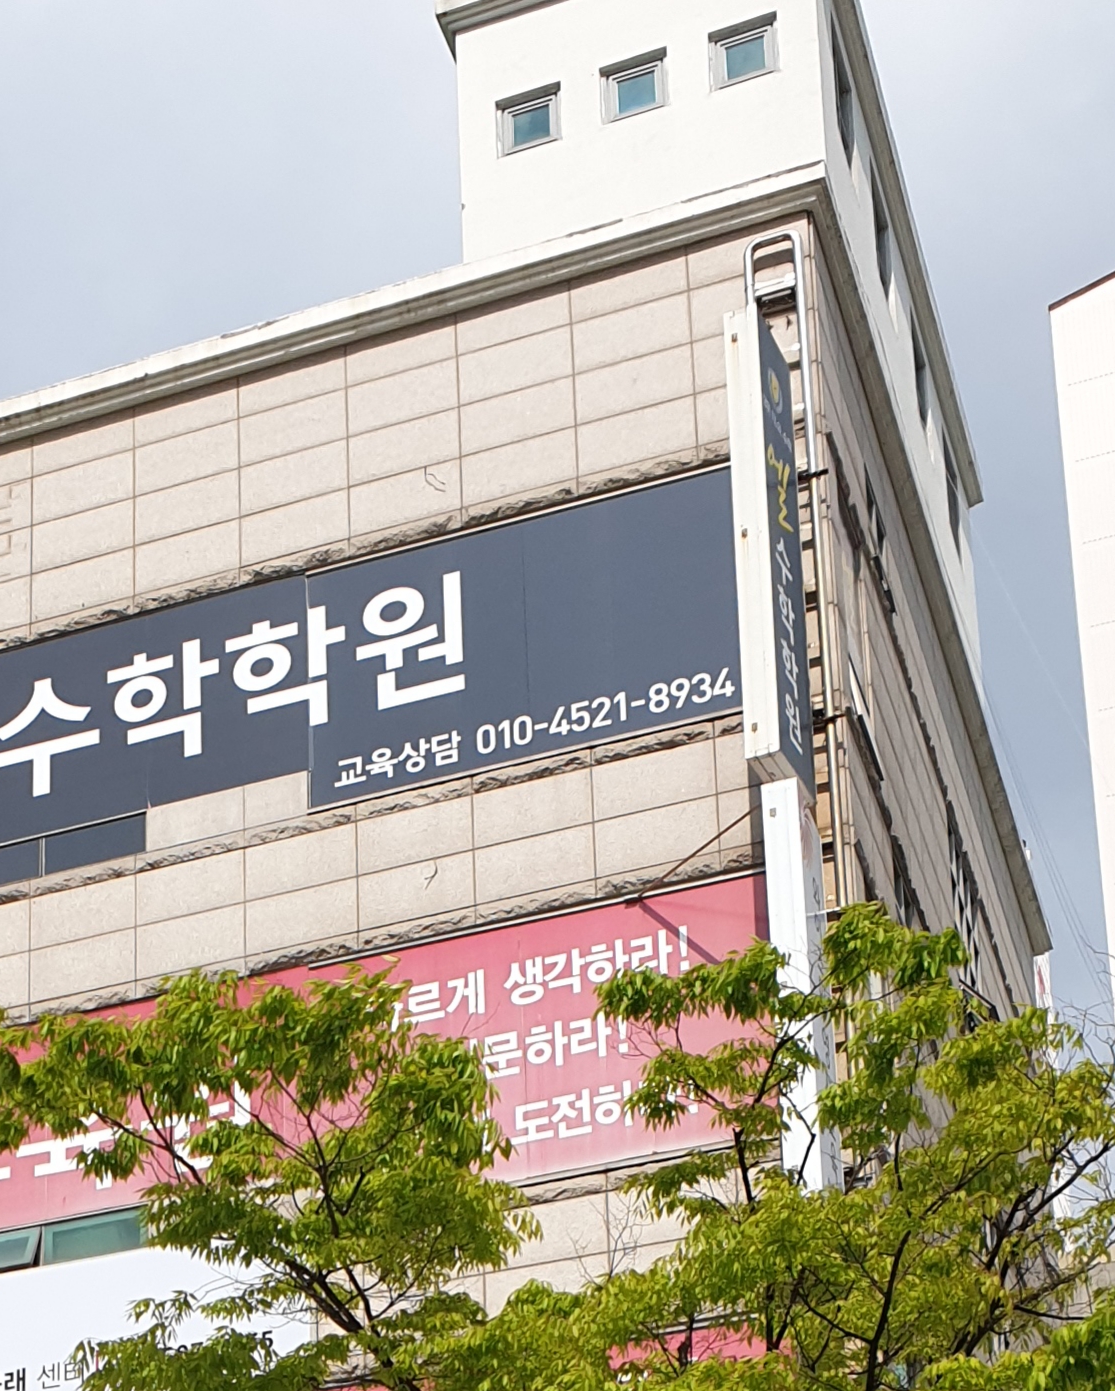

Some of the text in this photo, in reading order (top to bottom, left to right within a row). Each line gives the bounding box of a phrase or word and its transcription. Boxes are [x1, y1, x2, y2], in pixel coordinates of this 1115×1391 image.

[333, 666, 735, 790] 교육상담 010-4521-8934
[389, 925, 691, 1032] 르게 생각하라!
[470, 1010, 629, 1080] 문하라!
